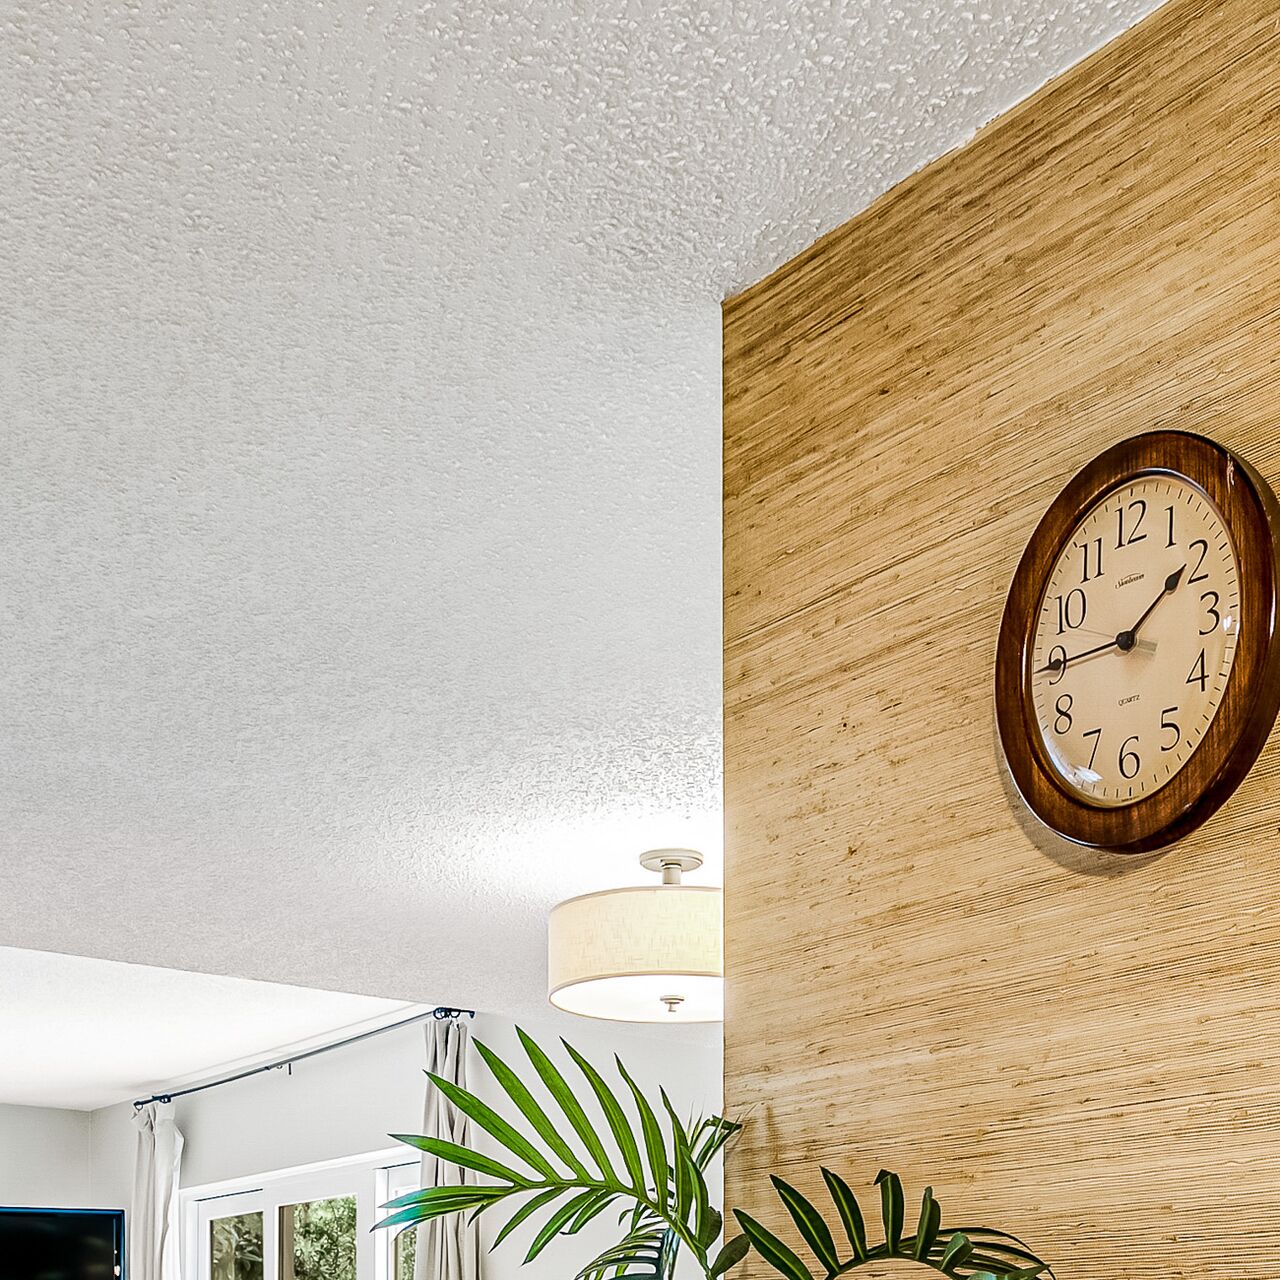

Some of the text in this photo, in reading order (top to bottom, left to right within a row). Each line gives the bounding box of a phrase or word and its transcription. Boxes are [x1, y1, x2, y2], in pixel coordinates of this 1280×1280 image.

[1114, 499, 1147, 550] 12
[1164, 505, 1177, 549] 1
[1079, 537, 1105, 584] 11
[1187, 539, 1209, 585] 2
[1056, 588, 1088, 634] 10
[1198, 590, 1220, 636] 3
[1049, 645, 1067, 686] 9
[1185, 647, 1210, 692] 4
[1054, 693, 1073, 735] 8
[1160, 706, 1181, 752] 5
[1082, 728, 1102, 771] 7
[1118, 735, 1141, 780] 6
